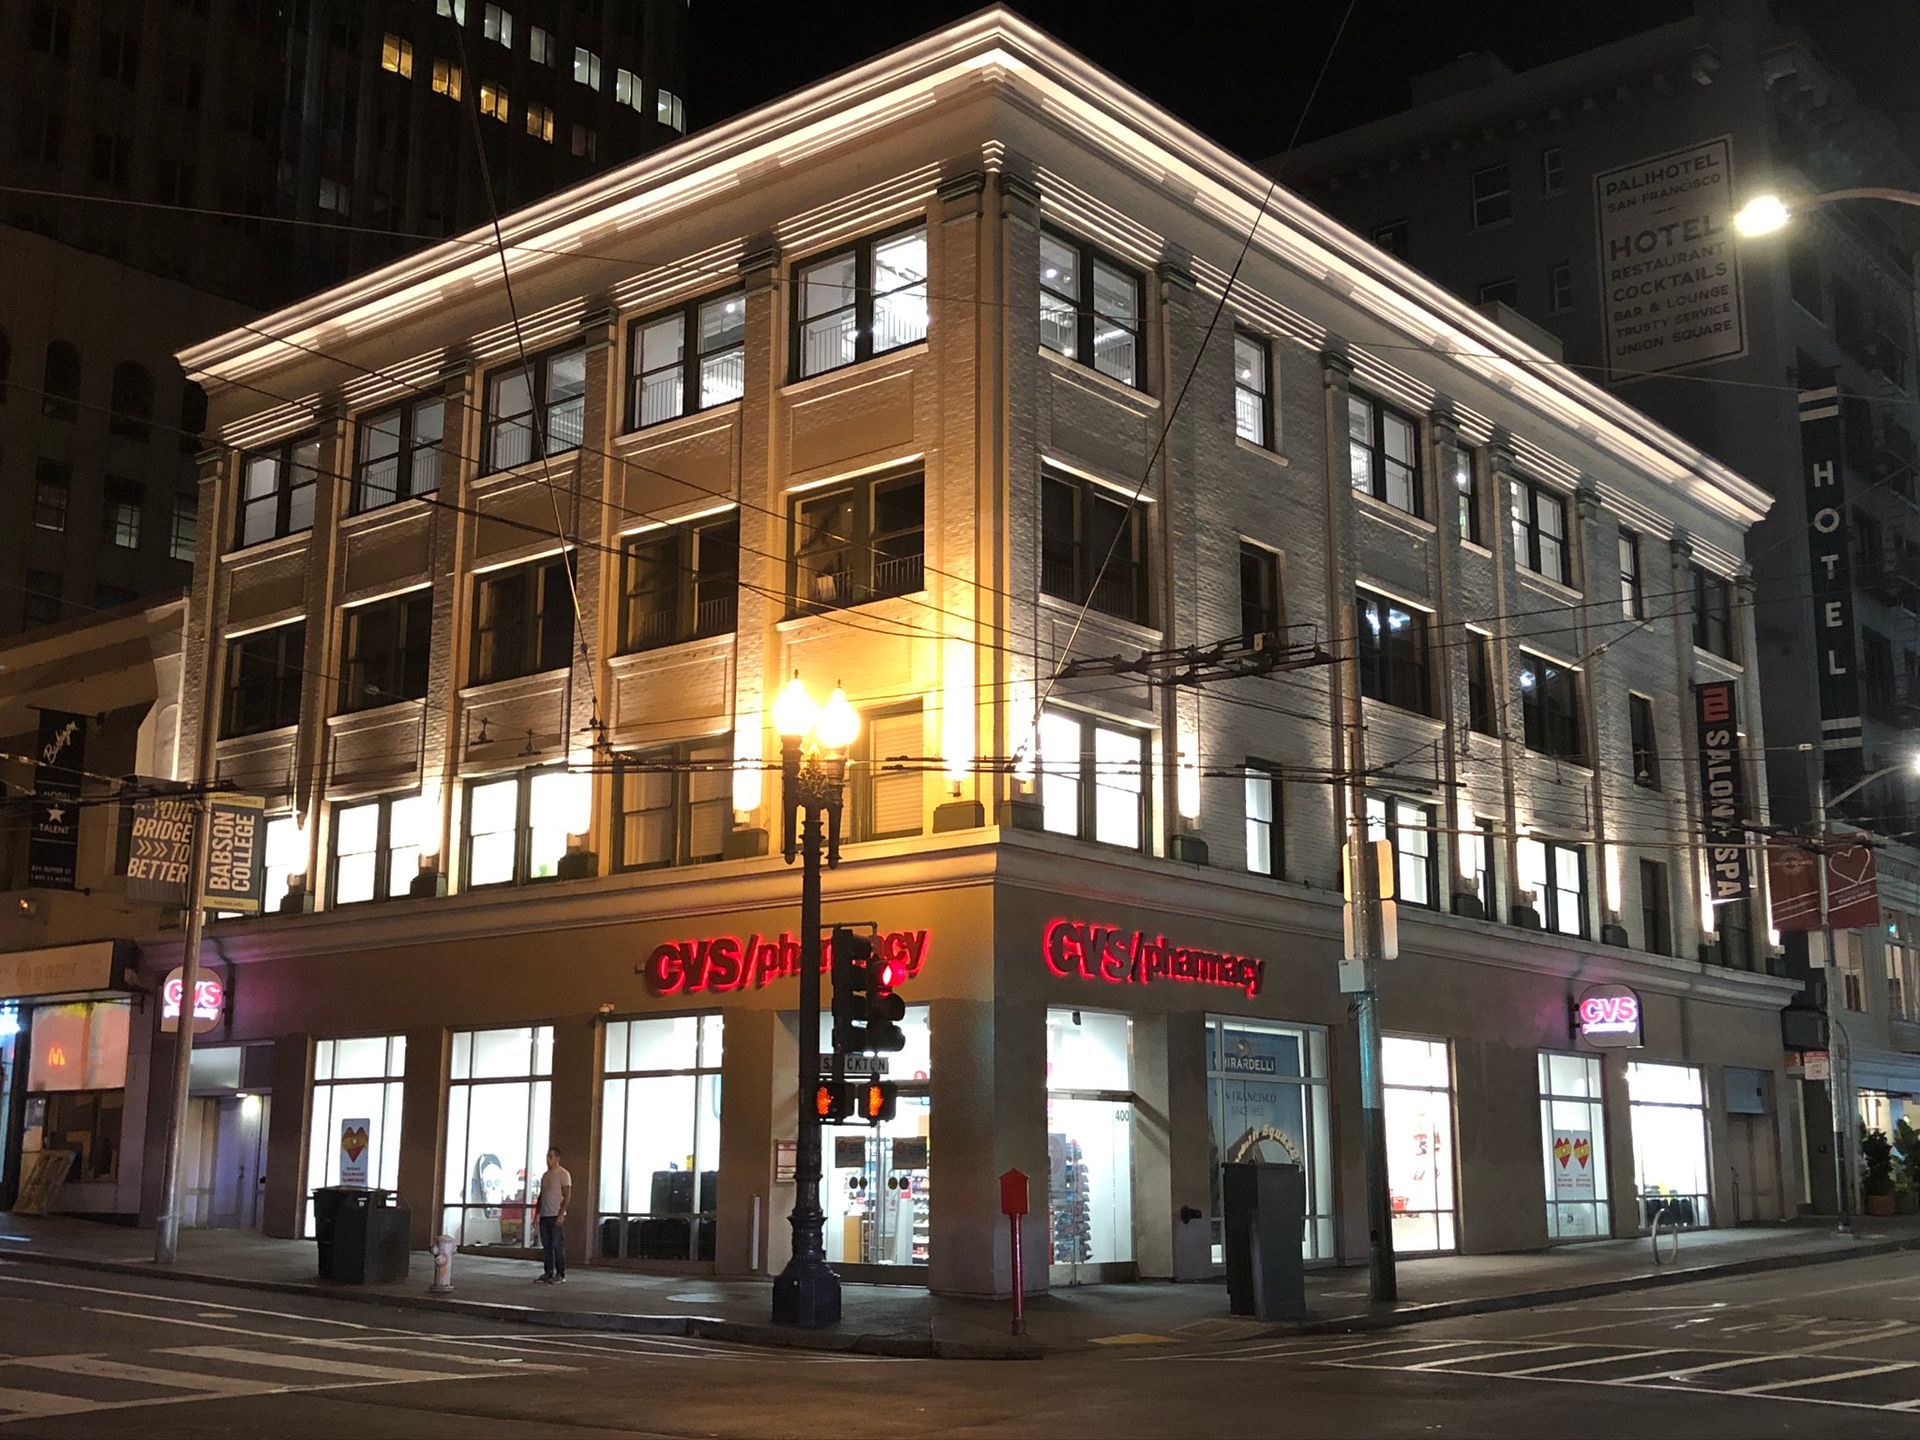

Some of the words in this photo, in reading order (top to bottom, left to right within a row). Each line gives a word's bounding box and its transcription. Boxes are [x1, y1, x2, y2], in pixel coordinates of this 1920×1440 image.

[1606, 153, 1720, 196] PALIHOTEL
[1607, 197, 1636, 214] SAN
[1642, 173, 1721, 203] FRANCISCO
[1610, 215, 1722, 261] HOTEL
[1611, 241, 1726, 282] RESTAURANT
[1612, 262, 1728, 302] COCKTAILS
[1614, 306, 1643, 322] BAR
[1650, 302, 1660, 313] &
[1667, 284, 1729, 309] LOUNGE
[1616, 318, 1670, 338] TRUSTY
[1675, 302, 1731, 325] SERVICE
[1616, 336, 1664, 357] UNION
[1673, 319, 1732, 343] SQUARE
[1813, 460, 1847, 675] HOTEL
[1706, 729, 1736, 819] SALON
[39, 823, 70, 835] TALENT
[153, 799, 194, 822] YOUR
[132, 817, 193, 843] BRIDGE
[171, 842, 190, 863] TO
[209, 811, 235, 890] BABSON
[231, 813, 255, 892] COLLEGE
[127, 858, 189, 883] BETTER
[1714, 846, 1743, 897] SPA
[645, 930, 930, 992] CVS/phacy
[1580, 997, 1638, 1023] CVS
[823, 1056, 886, 1071] SCKTN
[1215, 1056, 1275, 1072] IRARDELLI
[1115, 1109, 1130, 1122] 400
